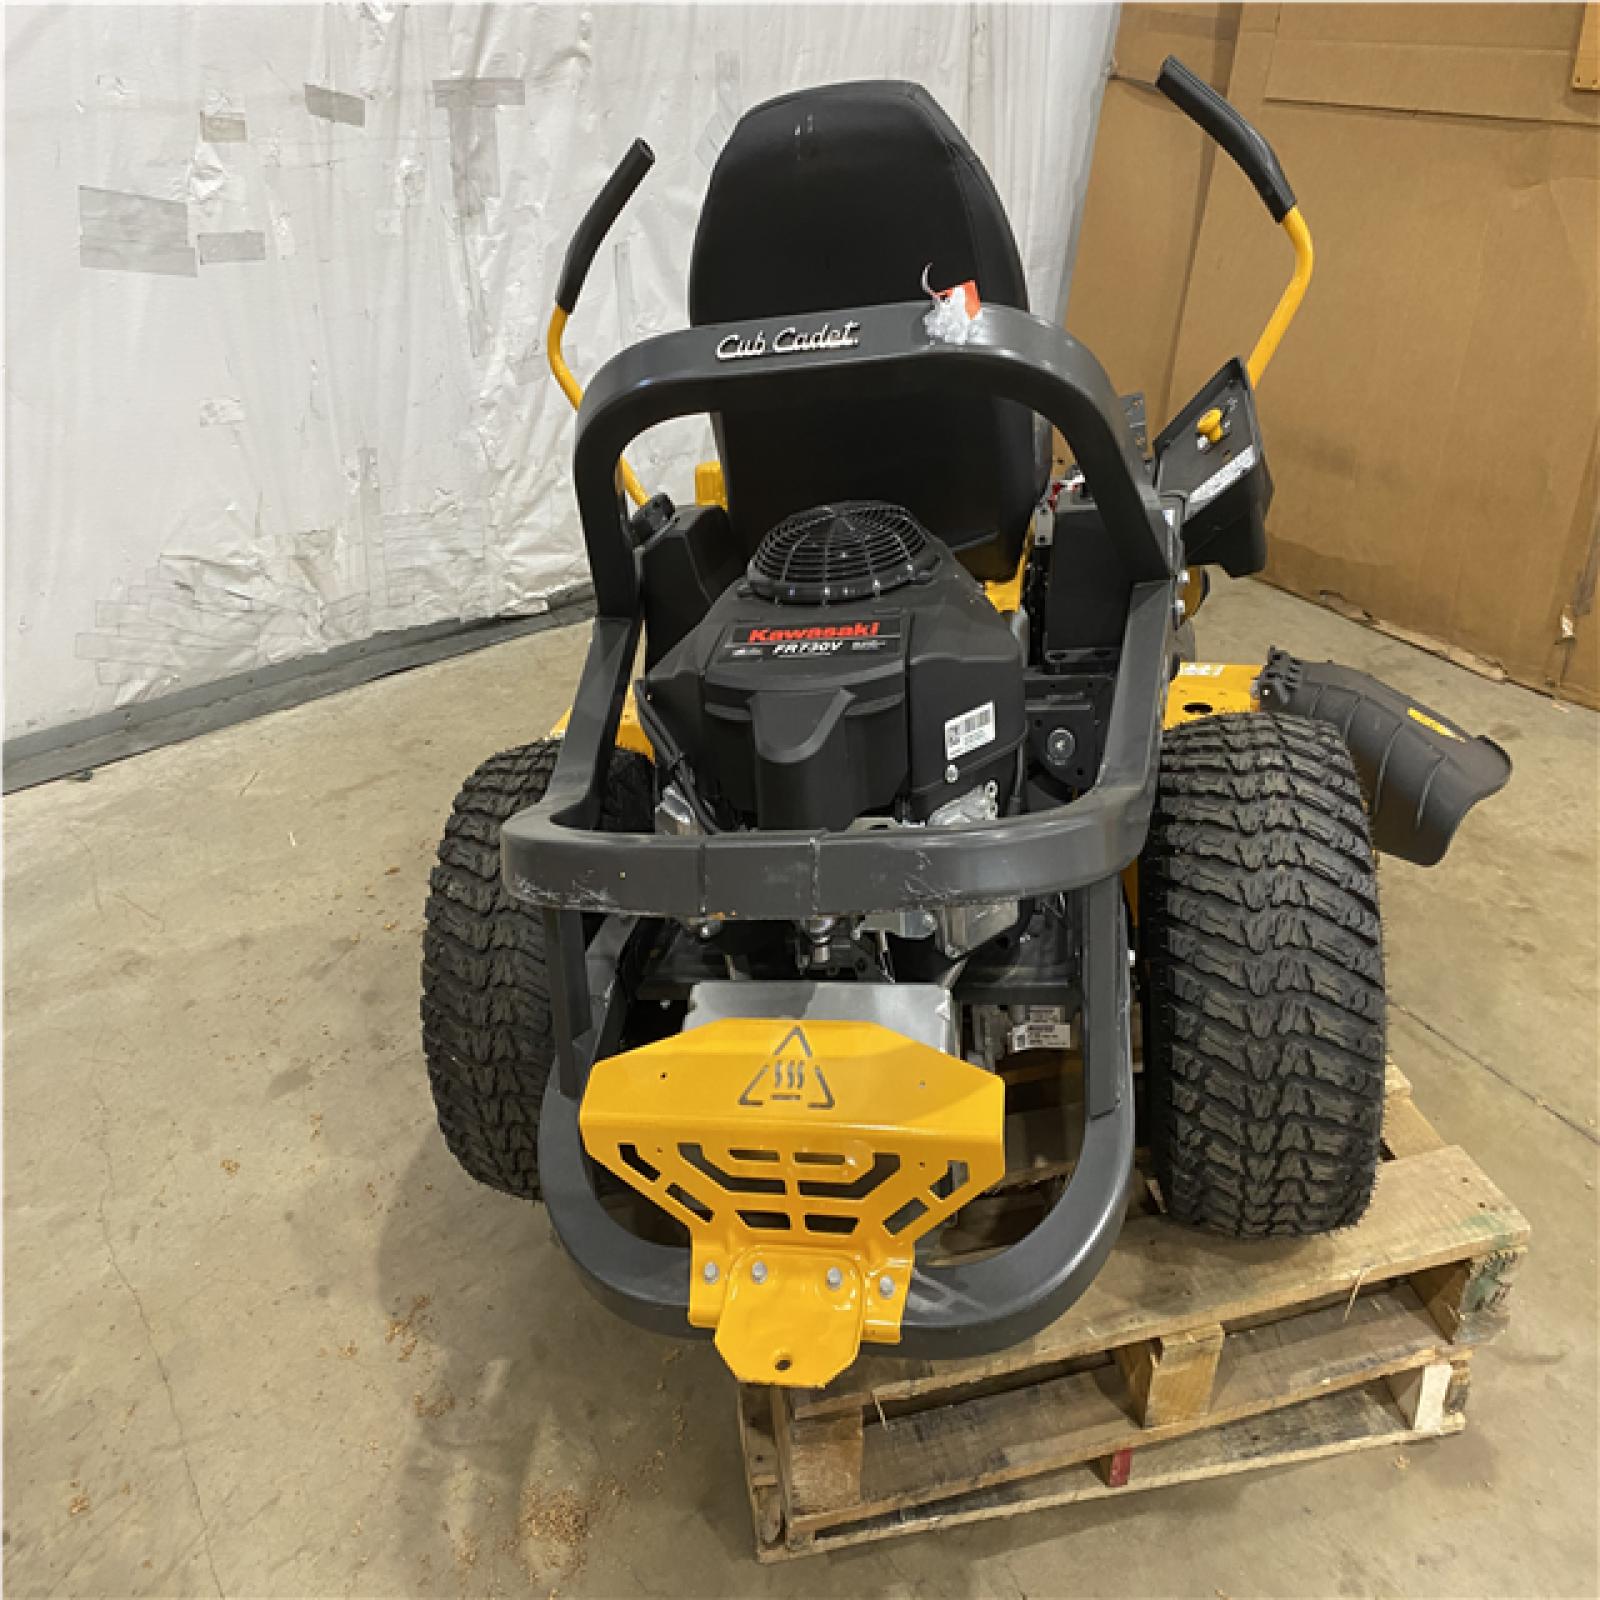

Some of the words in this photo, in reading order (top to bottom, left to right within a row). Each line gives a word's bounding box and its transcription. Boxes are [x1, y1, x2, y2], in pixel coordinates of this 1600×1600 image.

[716, 330, 765, 360] Cub
[773, 320, 860, 352] Cadet
[748, 621, 880, 643] Kawasaki
